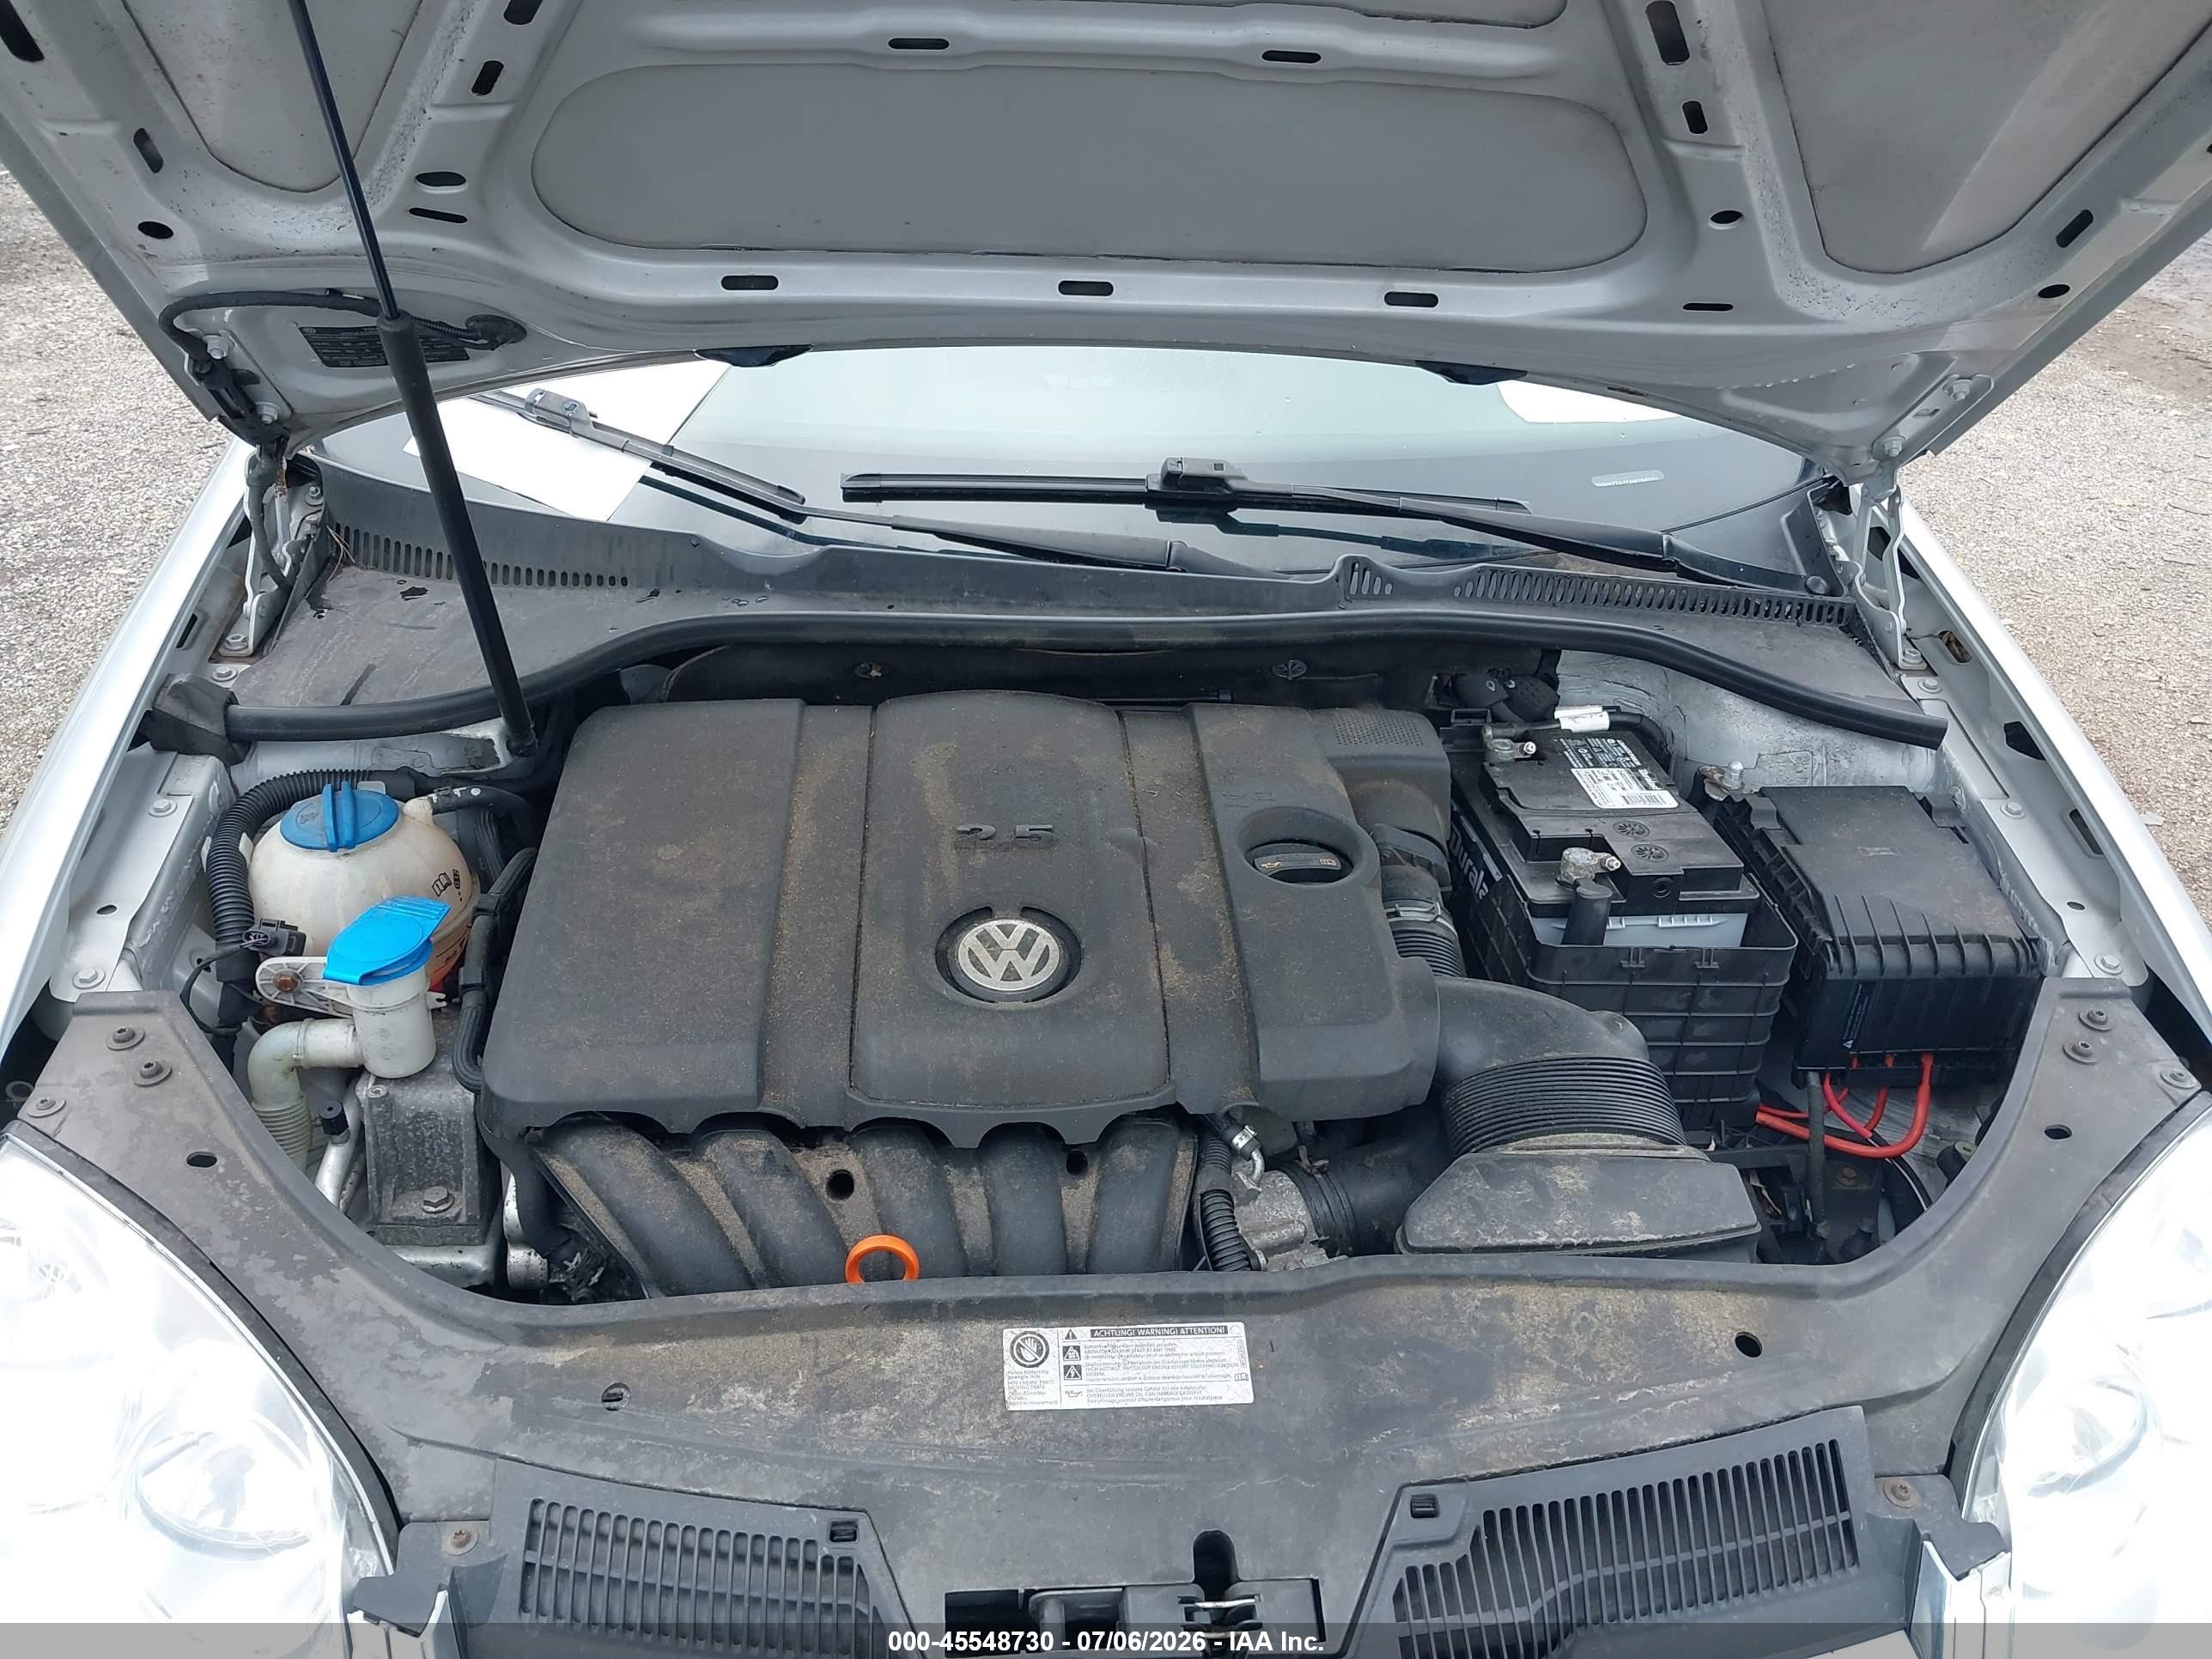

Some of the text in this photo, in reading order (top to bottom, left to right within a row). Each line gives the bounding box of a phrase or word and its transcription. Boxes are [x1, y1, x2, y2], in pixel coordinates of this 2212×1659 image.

[953, 823, 1057, 850] 2.5
[1094, 1326, 1225, 1338] ACHTUNG! WARNING! ATTENTION!
